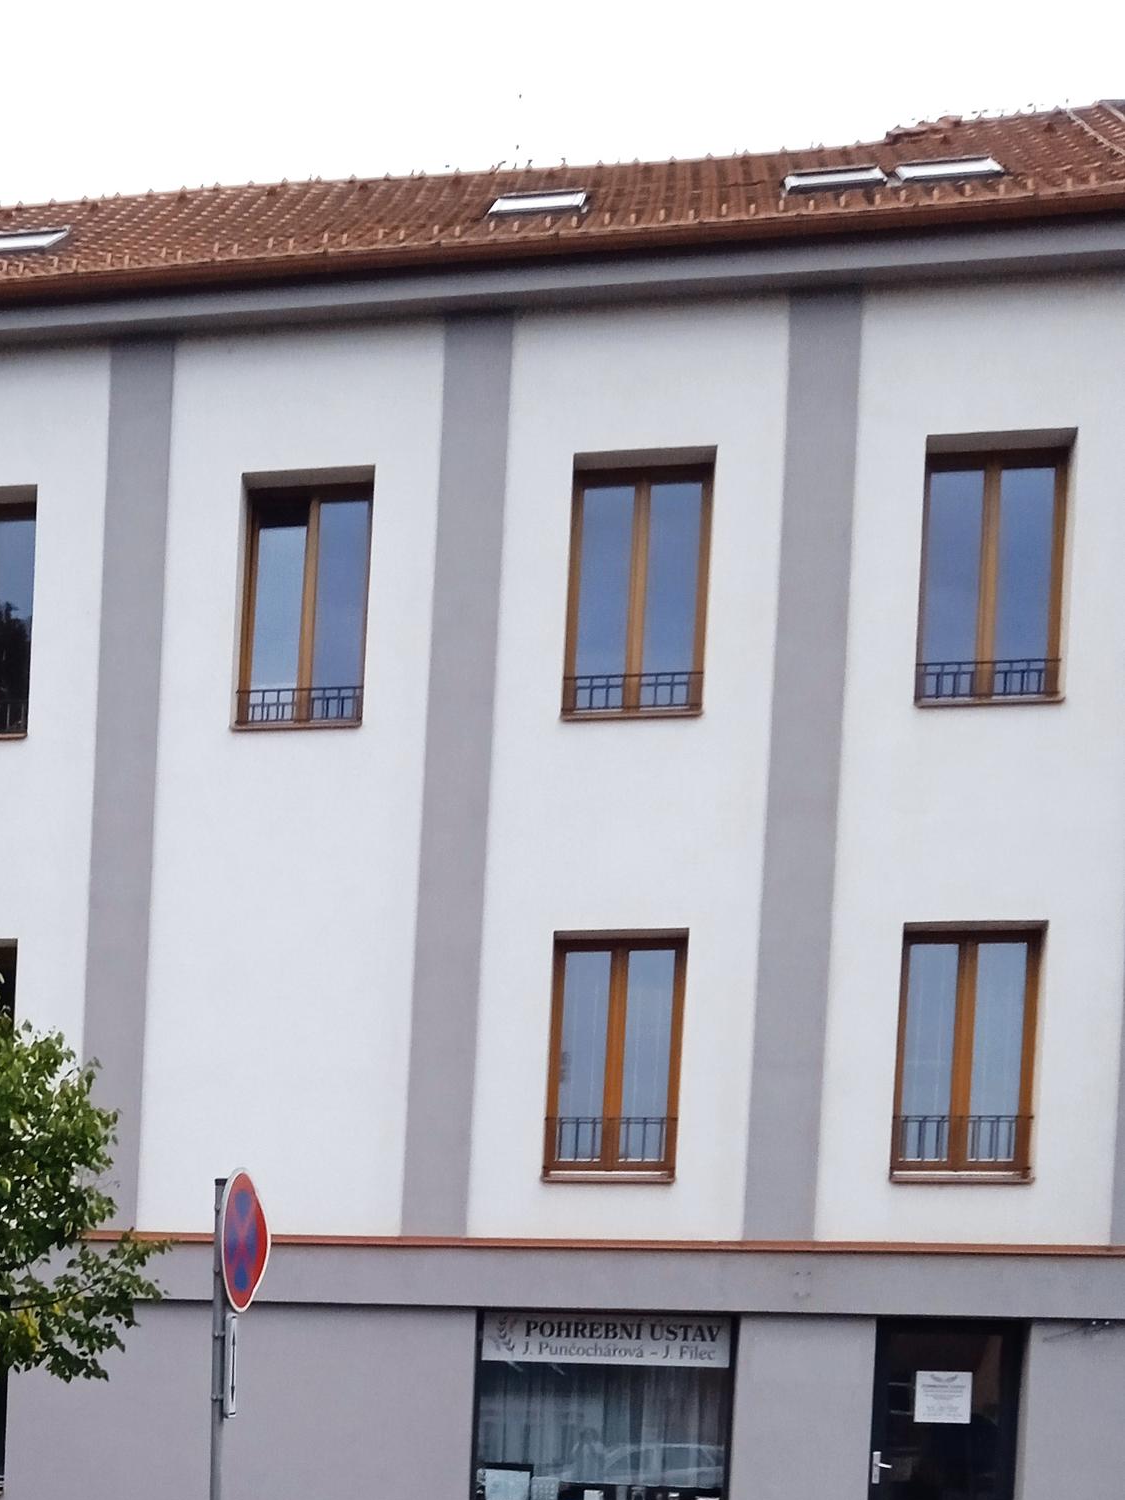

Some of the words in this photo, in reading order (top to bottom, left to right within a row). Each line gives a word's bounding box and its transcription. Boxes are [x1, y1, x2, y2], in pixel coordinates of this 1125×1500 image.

[524, 1316, 644, 1340] POHŘEBNÍ
[649, 1319, 722, 1342] ÚSTAV
[522, 1341, 532, 1355] J.
[662, 1344, 673, 1360] J.
[679, 1344, 717, 1361] Filec
